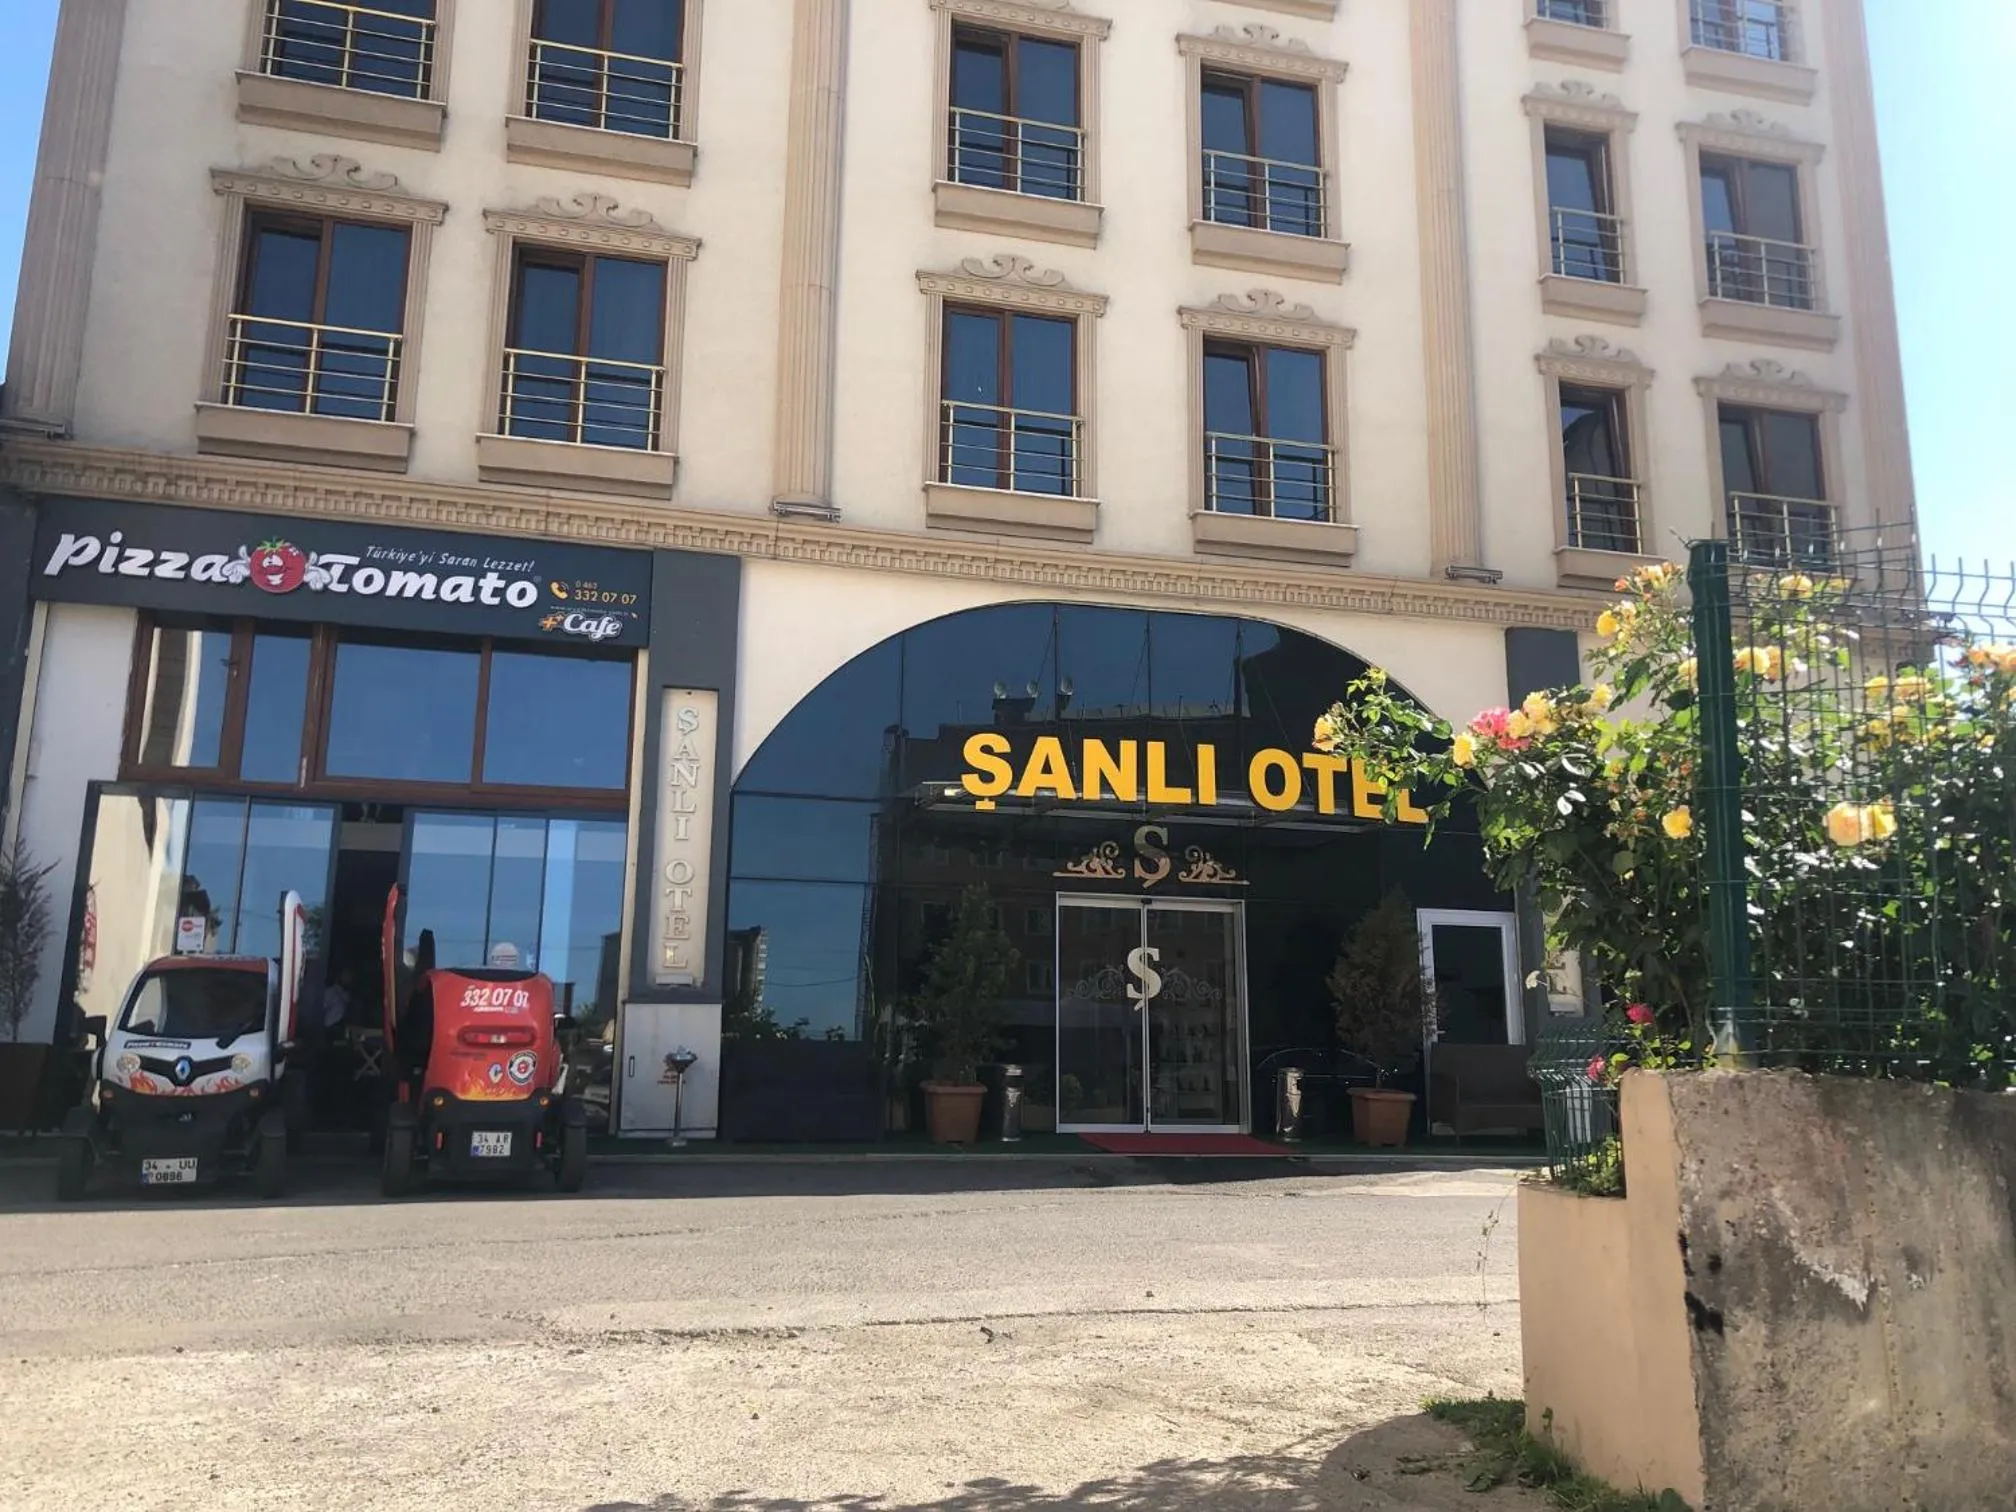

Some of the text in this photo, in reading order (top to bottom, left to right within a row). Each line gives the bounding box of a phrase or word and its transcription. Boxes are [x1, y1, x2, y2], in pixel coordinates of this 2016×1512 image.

[43, 531, 539, 609] pizza Tomato
[366, 545, 535, 573] Türkiye'yi Saran Lezzet!
[574, 589, 637, 605] 332 07 07
[563, 612, 622, 640] Cafe
[961, 732, 1430, 823] ŞANLI OTEL
[662, 859, 695, 968] OTEL
